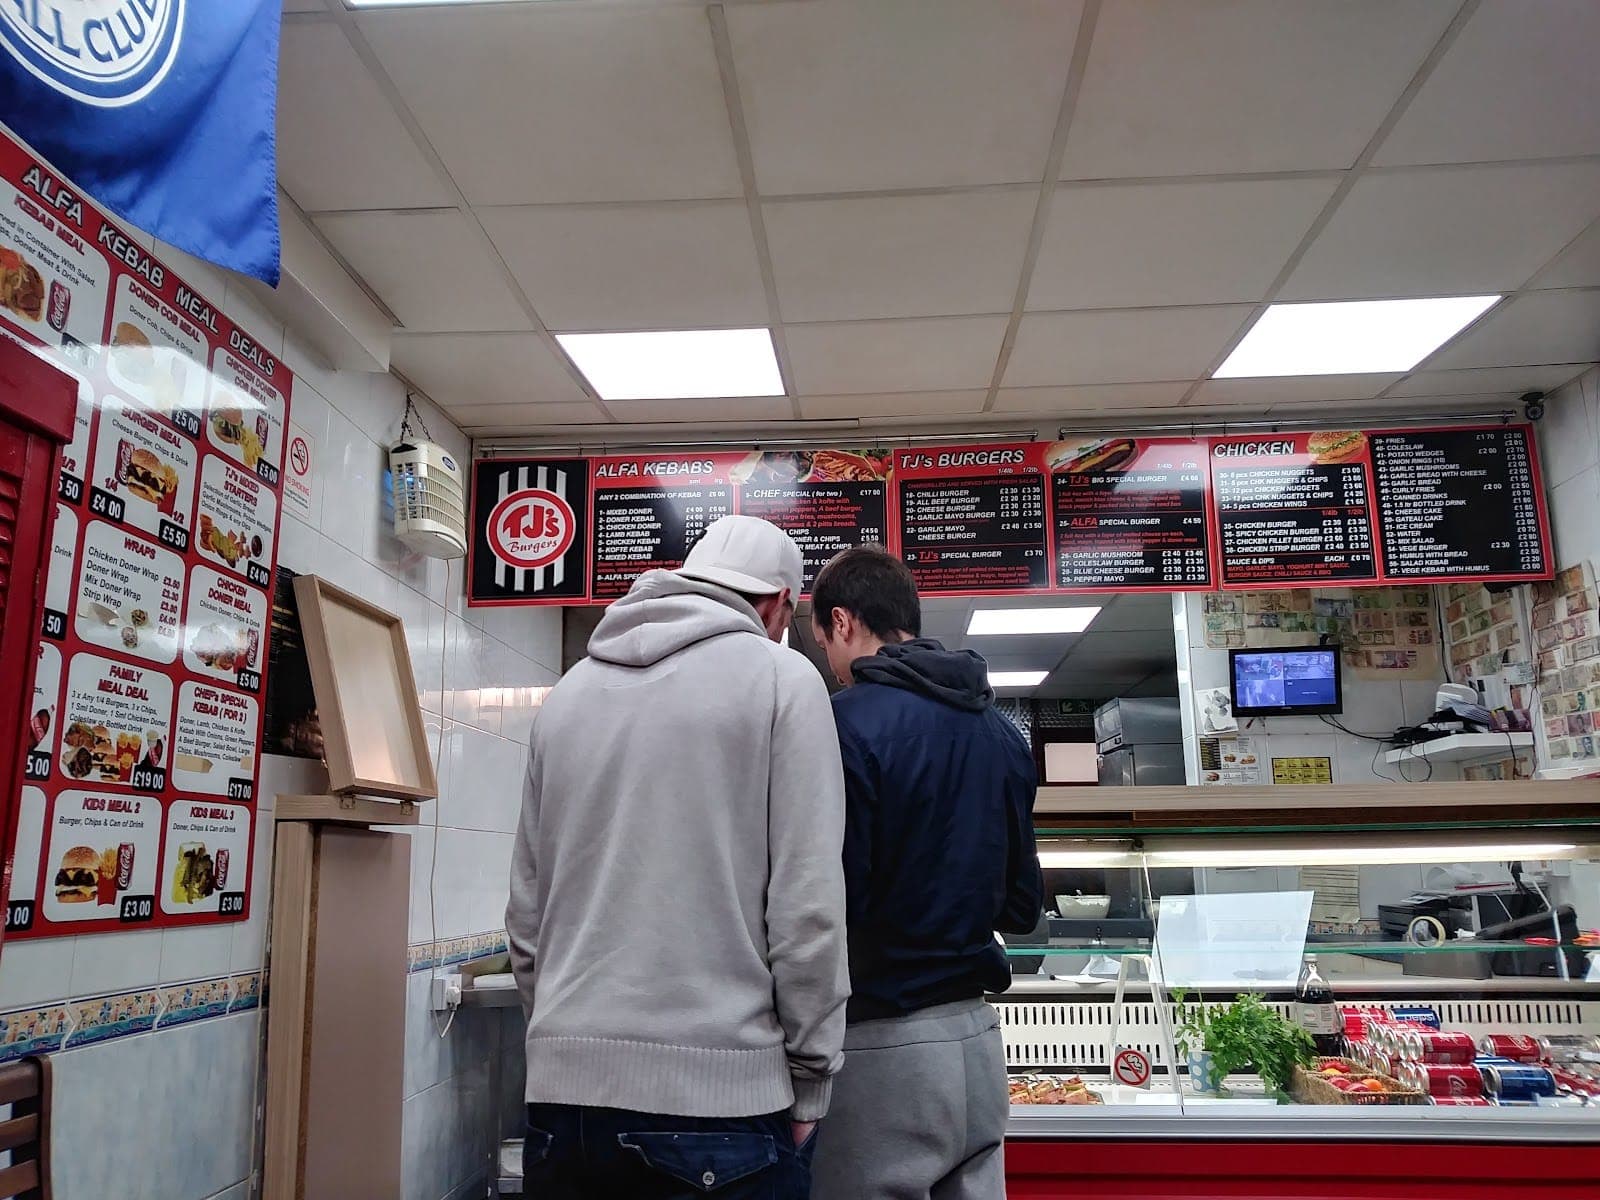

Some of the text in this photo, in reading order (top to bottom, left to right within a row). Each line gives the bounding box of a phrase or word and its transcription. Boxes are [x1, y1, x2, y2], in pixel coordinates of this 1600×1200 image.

[14, 194, 84, 255] KEBAB MEAL
[25, 231, 59, 259] Container
[60, 255, 75, 272] With
[12, 234, 79, 286] Doner Meat Drink
[23, 168, 273, 378] ALFA KEBAB MEAL DEALS
[128, 281, 200, 342] DONER COB MEAL
[225, 355, 277, 400] CHICKEN DONER
[121, 405, 181, 449] BURGER MEAL
[111, 418, 133, 435] Cheese
[154, 442, 169, 456] Chips
[174, 454, 188, 466] Drink
[1386, 443, 1424, 451] COLESLAW
[1213, 440, 1296, 458] CHICKEN
[1414, 449, 1445, 457] WEDGES
[900, 448, 1025, 469] TJ's BURGERS
[595, 457, 714, 478] ALFA KEBABS
[223, 480, 257, 506] STARTERS
[753, 488, 781, 498] CHEF
[916, 489, 969, 498] CHILLI BURGER
[1391, 485, 1436, 494] CURLY FRIES
[619, 490, 701, 501] COMBINATION OF KEBAB
[930, 496, 981, 505] BEEF BURGER
[1251, 500, 1283, 509] CHICKEN
[1411, 498, 1467, 507] BOTTLED DRINK
[605, 507, 653, 516] MIXED DONER
[916, 504, 976, 513] CHEESE BURGER
[605, 515, 655, 524] DONER KEBAB
[916, 510, 996, 521] GARLIC MAYO BURGER
[1069, 516, 1161, 526] ALFA SPECIAL BURGER
[502, 504, 560, 539] TJ's
[605, 522, 662, 531] CHICKEN DONER
[1233, 520, 1298, 529] CHICKEN BURGER
[917, 524, 965, 533] GARLIC MAYO
[1234, 527, 1320, 537] SPICY CHICKEN BURGER
[1396, 529, 1422, 537] WATER
[605, 530, 650, 539] LAMB KEBAB
[917, 531, 977, 540] CHEESE BURGER
[505, 540, 558, 553] Burgers
[605, 537, 661, 546] CHICKEN KEBAB
[124, 537, 155, 559] WRAPS
[628, 545, 653, 553] KEBAB
[604, 553, 626, 561] MIXED
[940, 551, 971, 559] SPECIAL
[971, 550, 1002, 558] BURGER
[1072, 550, 1143, 559] GARLIC MUSHROOM
[88, 546, 159, 582] Chicken Doner Wrap
[1072, 558, 1144, 567] COLESLAW BURGER
[1225, 557, 1251, 565] SAUCE
[86, 559, 128, 584] Doner Wrap
[1123, 566, 1155, 574] BURGER
[1073, 575, 1103, 583] PEPPER
[84, 572, 141, 602] Mix Doner Wrap
[217, 577, 247, 597] CHICKEN
[82, 586, 121, 608] Strip Wrap
[208, 587, 251, 613] DONER MEAL
[109, 665, 142, 682] FAMILY
[97, 678, 148, 701] MEAL DEAL
[220, 693, 248, 709] SPECIAL
[192, 701, 218, 716] KEBAB
[82, 797, 140, 813] KIDS MEAL 2
[189, 806, 234, 820] KIDS MEAL 3
[58, 815, 144, 828] Burger, Chips Can of Drink
